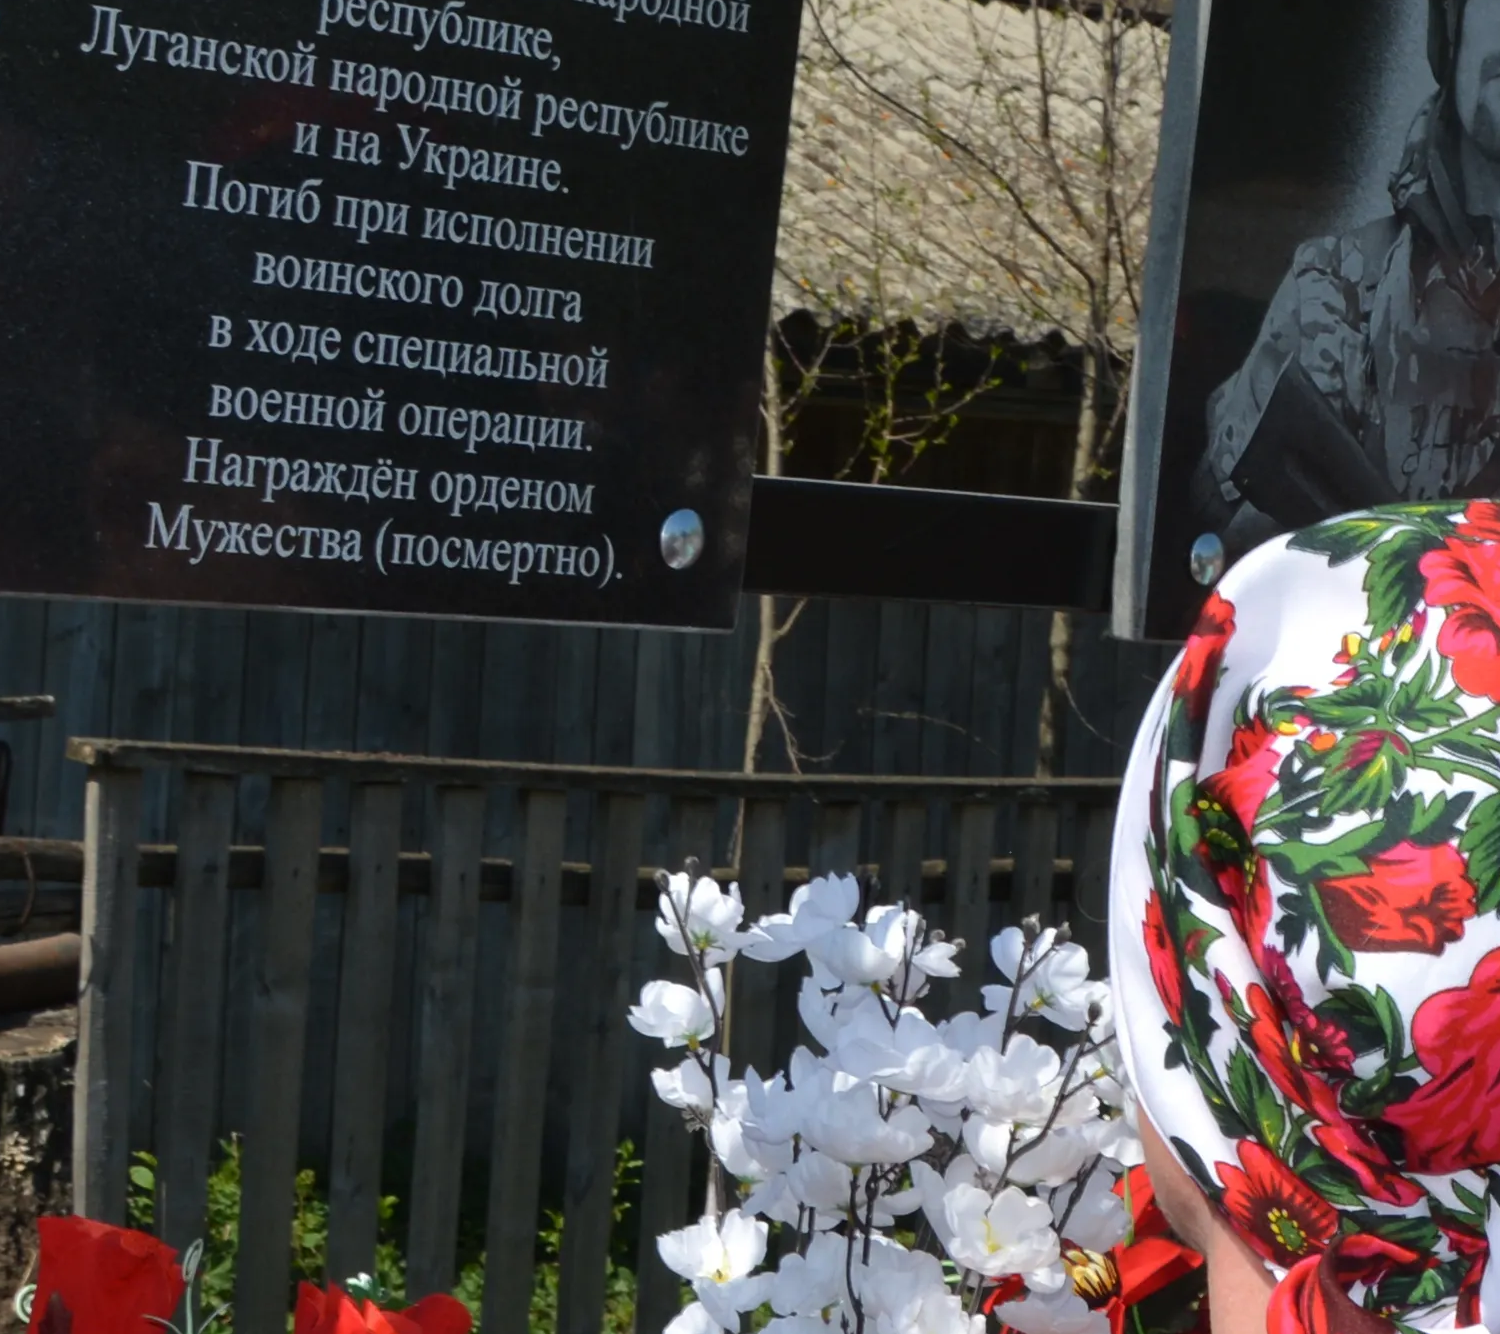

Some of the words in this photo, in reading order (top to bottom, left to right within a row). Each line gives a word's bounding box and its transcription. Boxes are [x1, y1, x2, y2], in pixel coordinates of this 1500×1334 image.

[80, 4, 315, 89] Луганской
[329, 58, 522, 122] народной
[532, 89, 750, 157] республике
[293, 119, 318, 157] и
[333, 127, 382, 166] на
[397, 122, 568, 195] Украине.
[181, 160, 321, 224] Погиб
[332, 193, 409, 245] при
[423, 205, 655, 270] исполнении
[252, 250, 463, 310] воинского
[473, 277, 584, 323] долга
[209, 312, 232, 348] в
[245, 314, 341, 363] ходе
[353, 330, 609, 390] специальной
[209, 383, 385, 435] военной
[397, 399, 592, 454] операции.
[181, 436, 416, 503] Награждён
[430, 470, 594, 520] орденом
[144, 501, 362, 565] Мужества
[375, 520, 623, 590] (посмертно).
